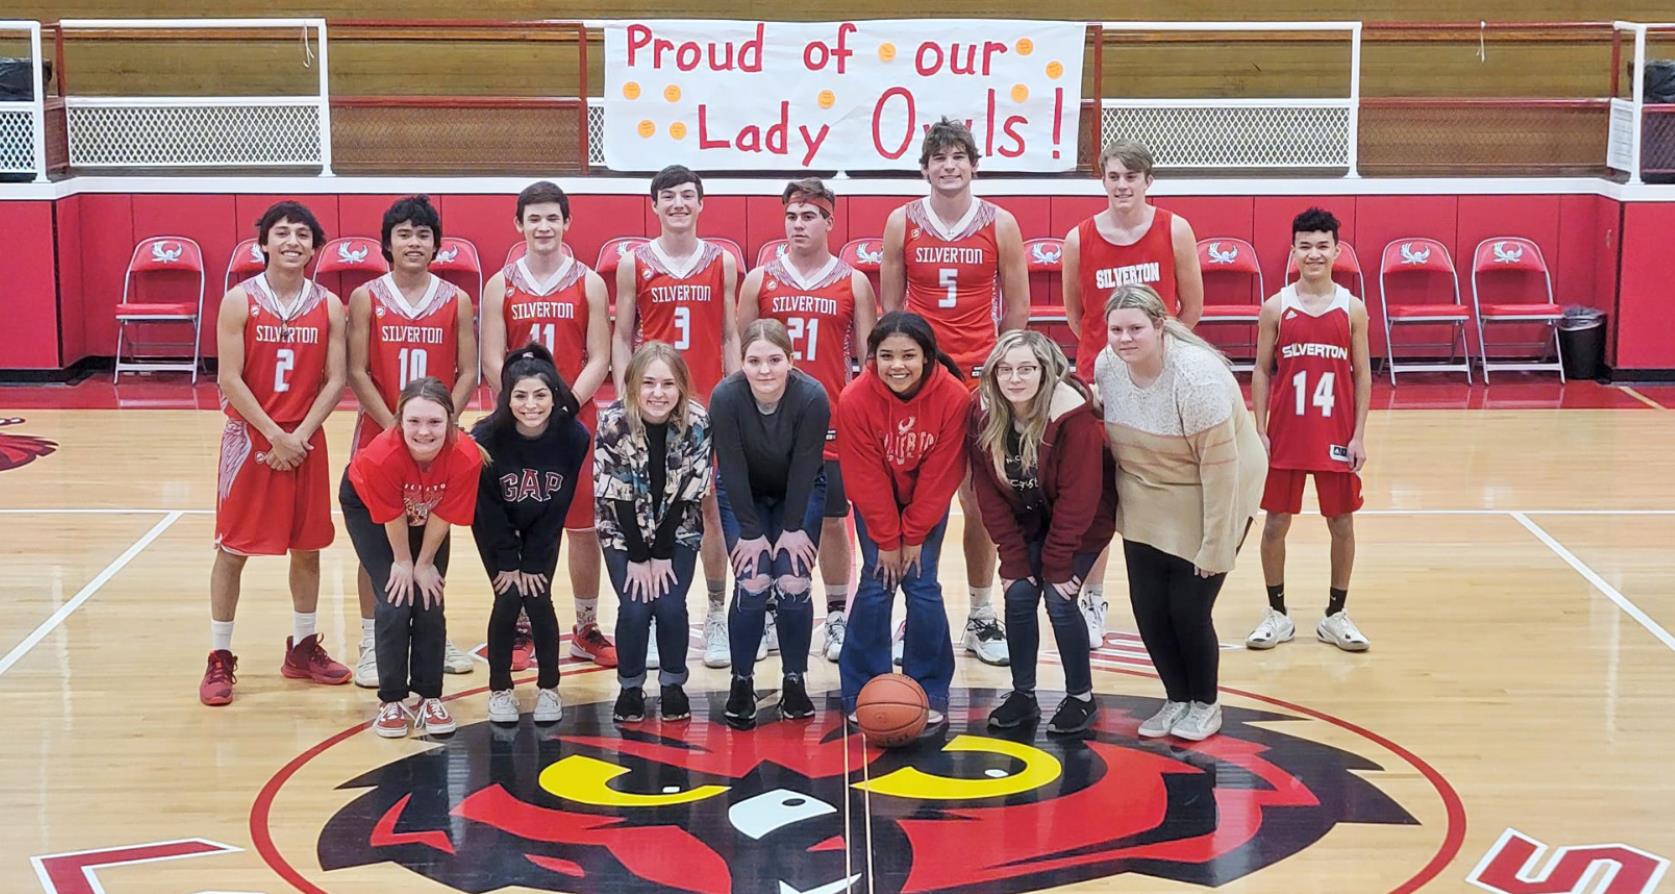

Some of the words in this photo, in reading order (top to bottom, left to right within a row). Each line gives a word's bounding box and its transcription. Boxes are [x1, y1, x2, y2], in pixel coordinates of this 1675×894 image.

[627, 23, 765, 73] Proud
[803, 23, 857, 74] of
[915, 40, 1008, 76] our
[699, 101, 830, 167] Lady
[872, 86, 1064, 161] Ols!
[915, 247, 983, 264] SILVERTON
[651, 284, 711, 303] SILVERTON
[938, 268, 958, 308] 5
[1096, 262, 1160, 290] SILVERTON
[511, 301, 574, 320] SILVERTON
[772, 295, 837, 316] SILVERTON
[382, 325, 443, 344] SILVERTON
[674, 306, 690, 350] 3
[787, 317, 819, 361] 21
[273, 348, 295, 392] 2
[398, 347, 428, 391] 10
[1292, 370, 1335, 417] 14
[499, 468, 563, 502] GAP
